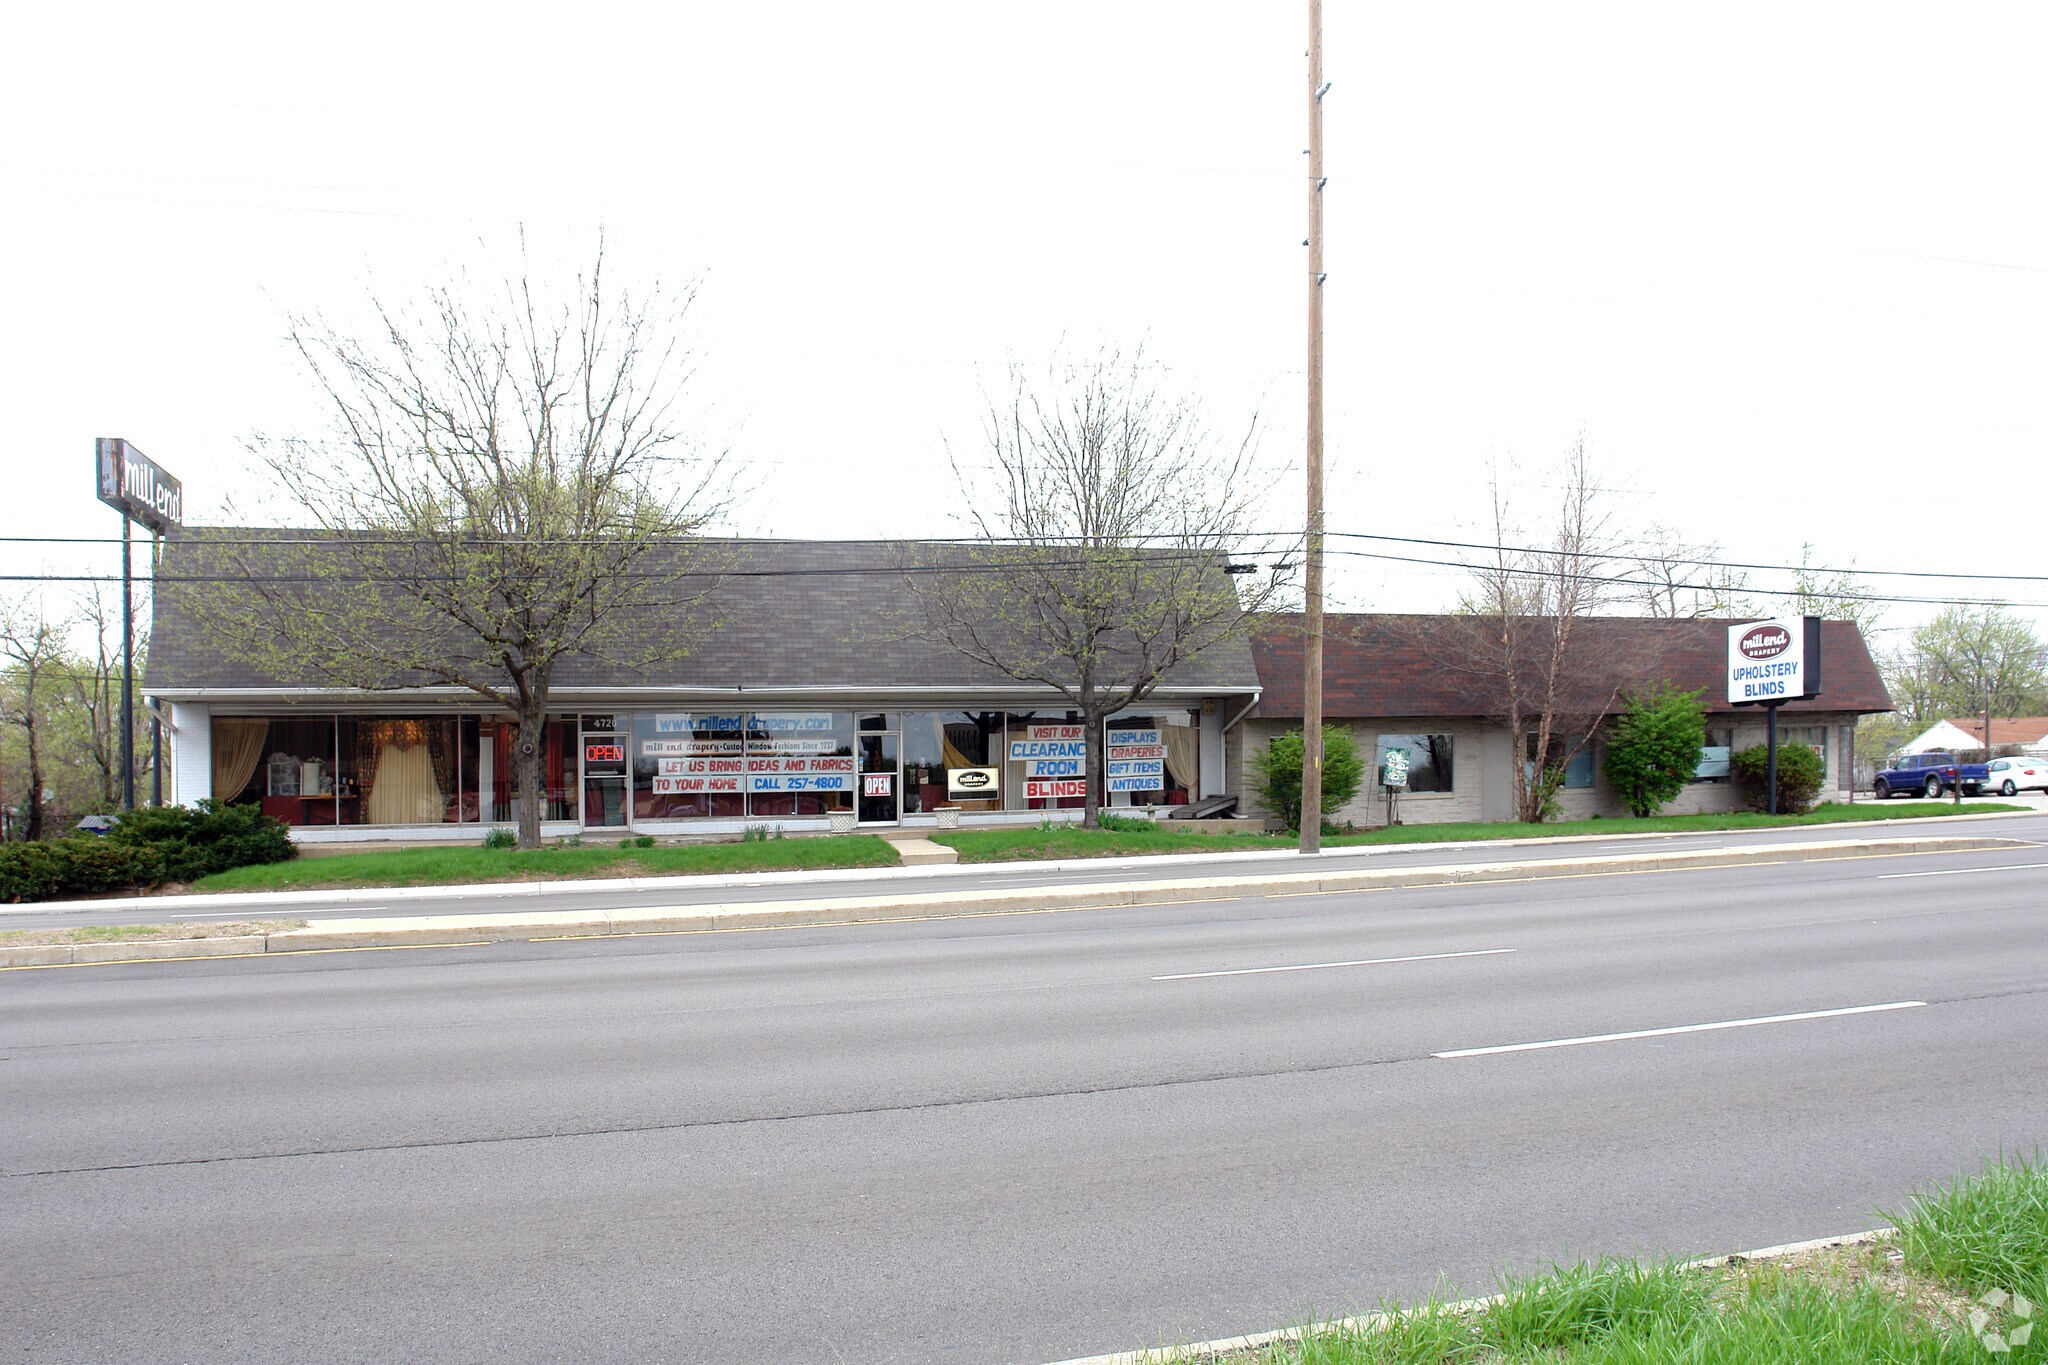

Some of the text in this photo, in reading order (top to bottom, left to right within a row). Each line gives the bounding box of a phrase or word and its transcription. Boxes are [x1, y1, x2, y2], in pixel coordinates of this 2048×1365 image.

[121, 459, 181, 522] mill end
[1743, 631, 1787, 649] mill end
[1749, 647, 1781, 656] DRAPERY
[1733, 661, 1798, 681] UPHOLSTERY
[1745, 680, 1785, 697] BLINDS
[594, 719, 617, 728] 4720
[1033, 727, 1081, 738] VISIT OUR
[1111, 732, 1157, 743] DISPLAYS
[645, 743, 663, 751] mill
[666, 743, 682, 751] end
[747, 742, 772, 751] Window
[774, 742, 800, 750] Fashions
[802, 741, 818, 750] Since
[1011, 743, 1088, 757] CLEARANC
[1111, 745, 1164, 758] DRAPERIES
[586, 746, 623, 761] OPEN
[665, 761, 685, 773] LET
[688, 760, 705, 772] US
[709, 760, 743, 772] BRING
[747, 759, 780, 772] IDEAS
[783, 759, 806, 771] AND
[810, 758, 853, 771] FABRICS
[1036, 761, 1078, 775] ROOM
[1109, 762, 1161, 774] GIFT ITEMS
[655, 776, 843, 791] TO YOUR HOME CALL 257-4800
[866, 777, 890, 794] OPEN
[1027, 781, 1087, 797] BLINDS
[1112, 778, 1160, 790] ANTIQUES
